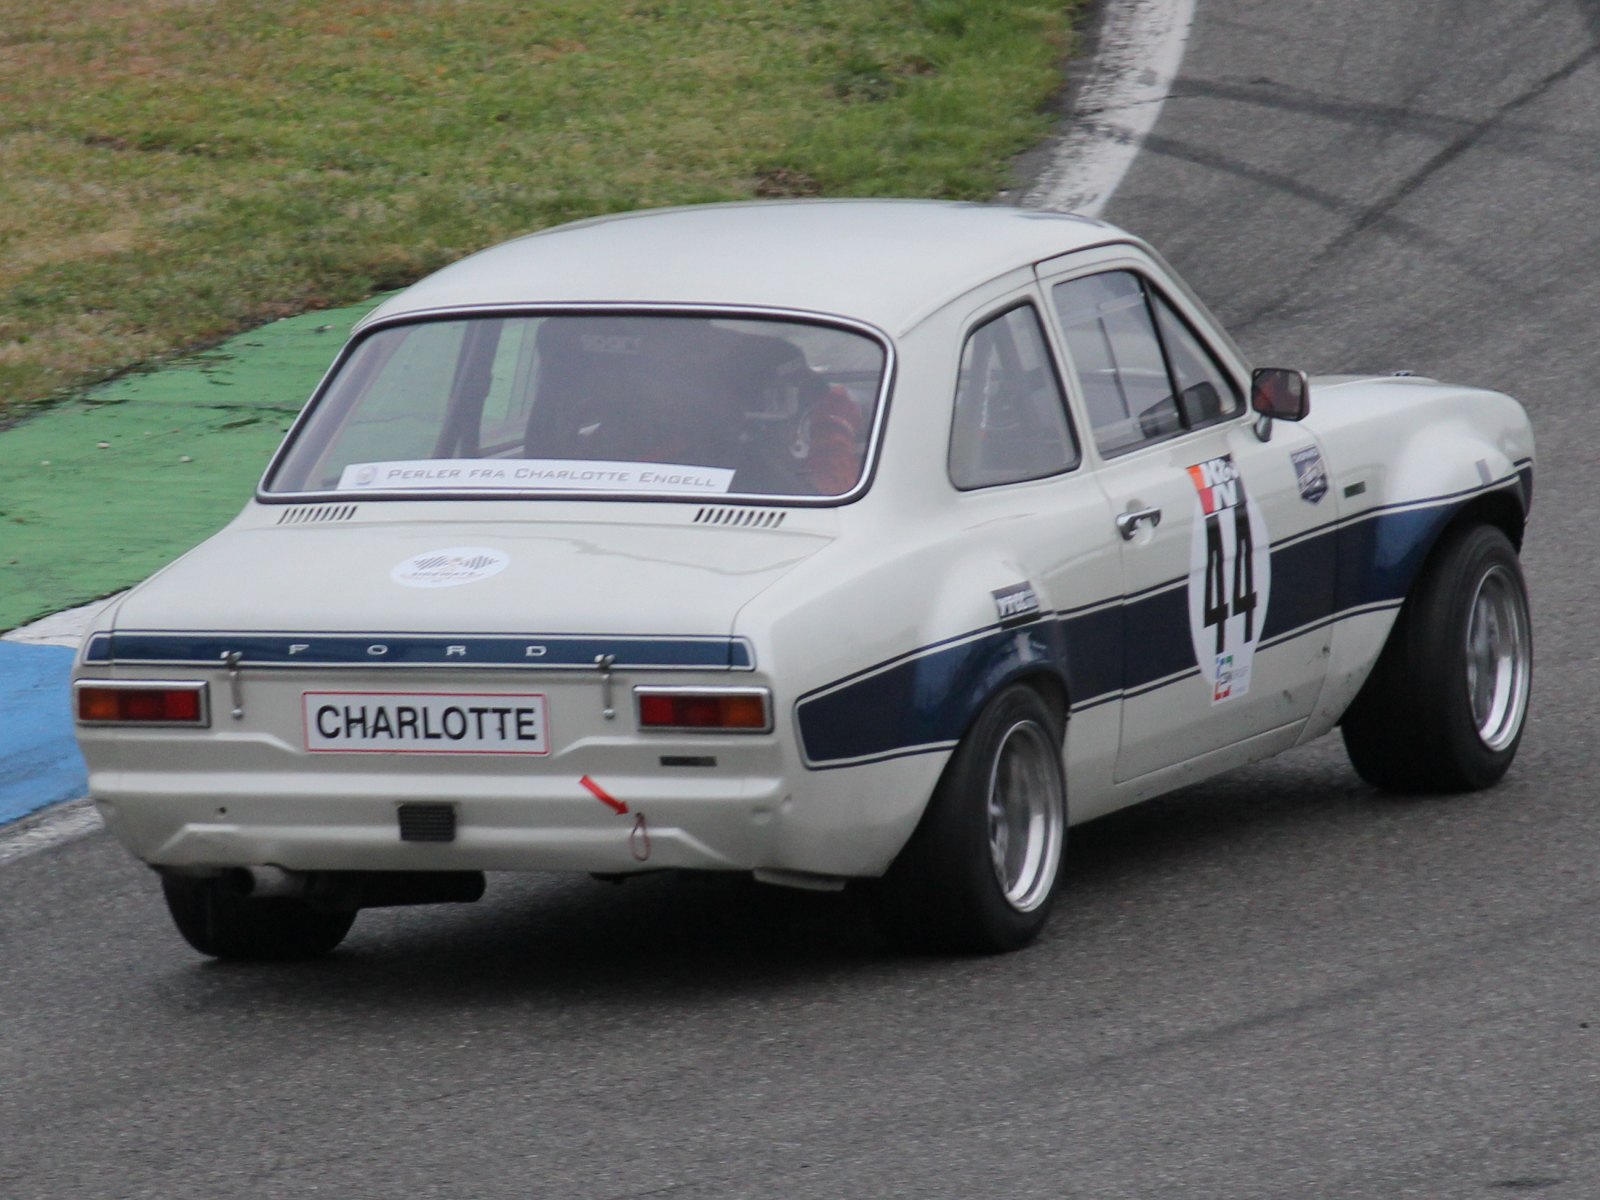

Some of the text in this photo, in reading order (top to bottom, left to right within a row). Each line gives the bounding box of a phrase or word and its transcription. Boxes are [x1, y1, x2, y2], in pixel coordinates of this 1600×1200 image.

[387, 468, 716, 488] PERLER FRA CHARLOTTE ENGELL
[1203, 503, 1257, 655] 44
[288, 643, 547, 657] FORD
[316, 704, 538, 741] CHARLOTTE
